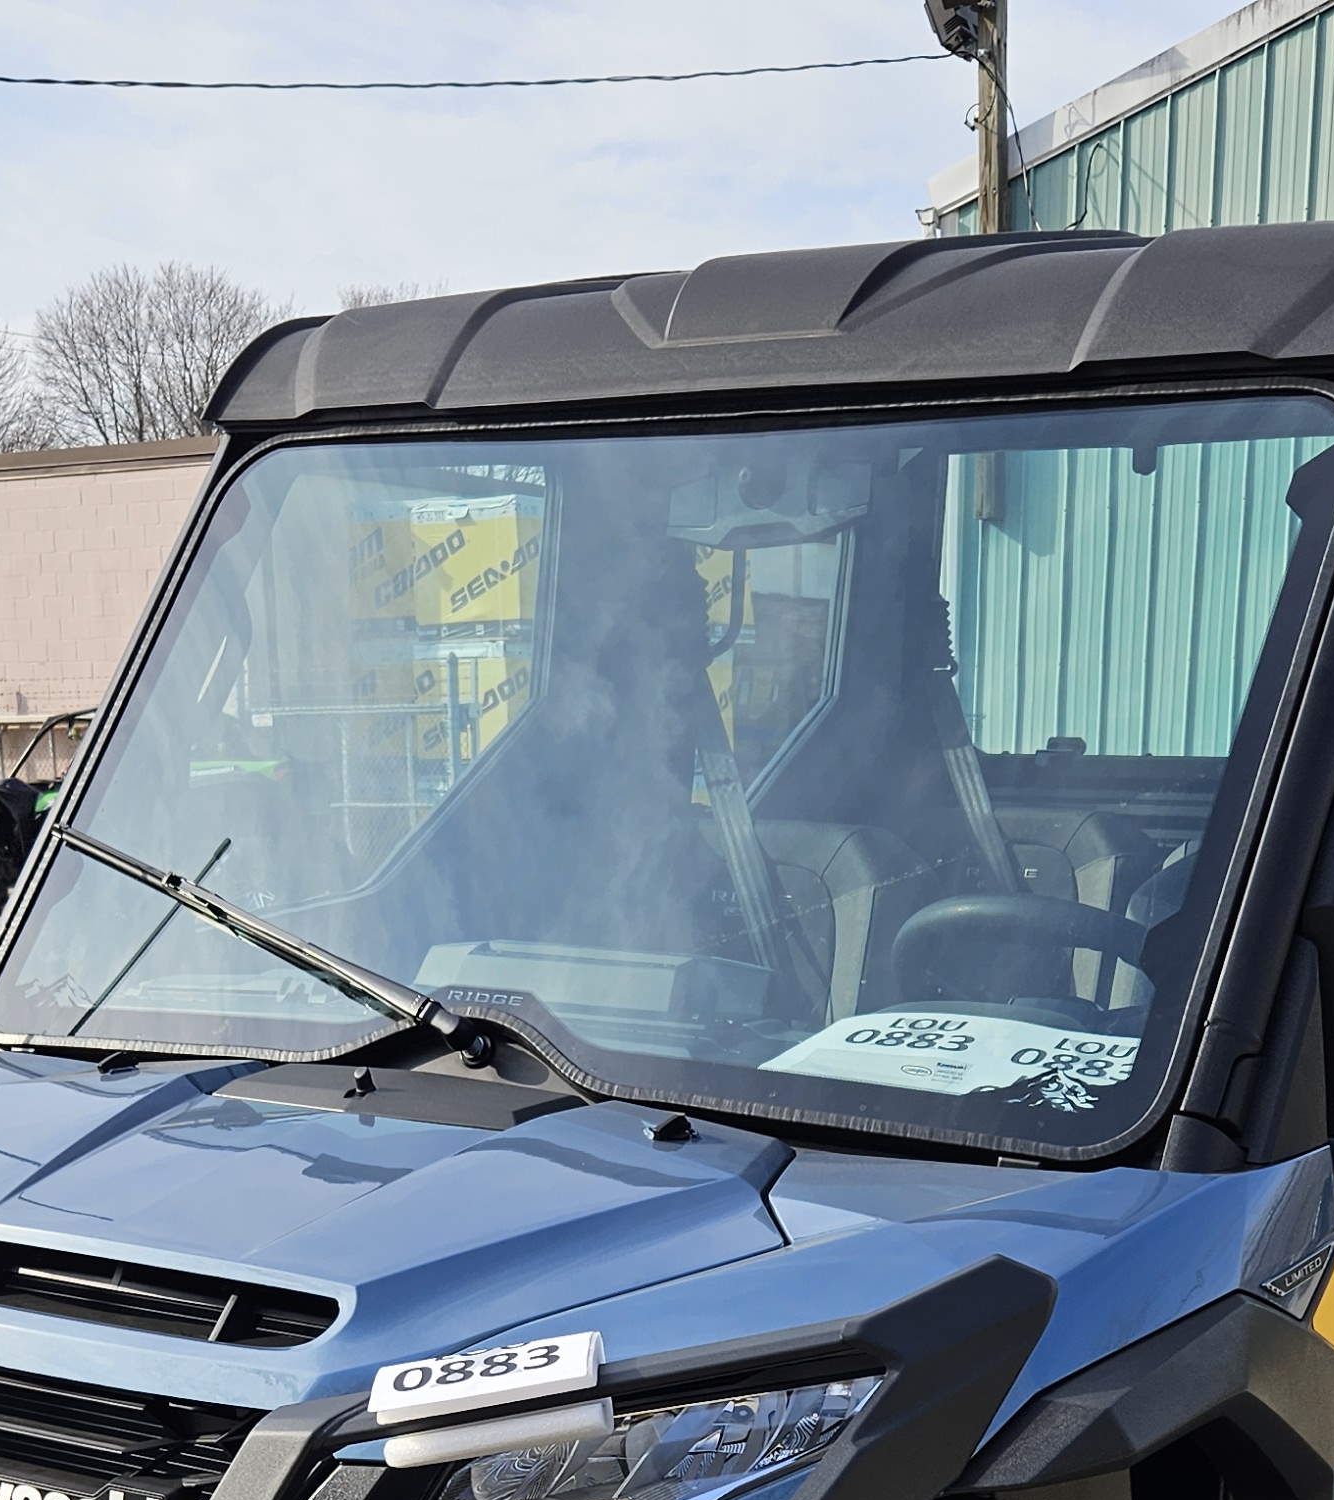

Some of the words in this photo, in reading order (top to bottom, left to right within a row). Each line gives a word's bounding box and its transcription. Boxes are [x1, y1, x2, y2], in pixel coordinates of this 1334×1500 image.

[447, 989, 524, 1007] RIDGE
[888, 1017, 969, 1032] LOU
[845, 1028, 976, 1051] 0883
[1054, 1037, 1138, 1059] LOU
[1284, 1256, 1323, 1287] LIMITED
[393, 1344, 560, 1392] 0883
